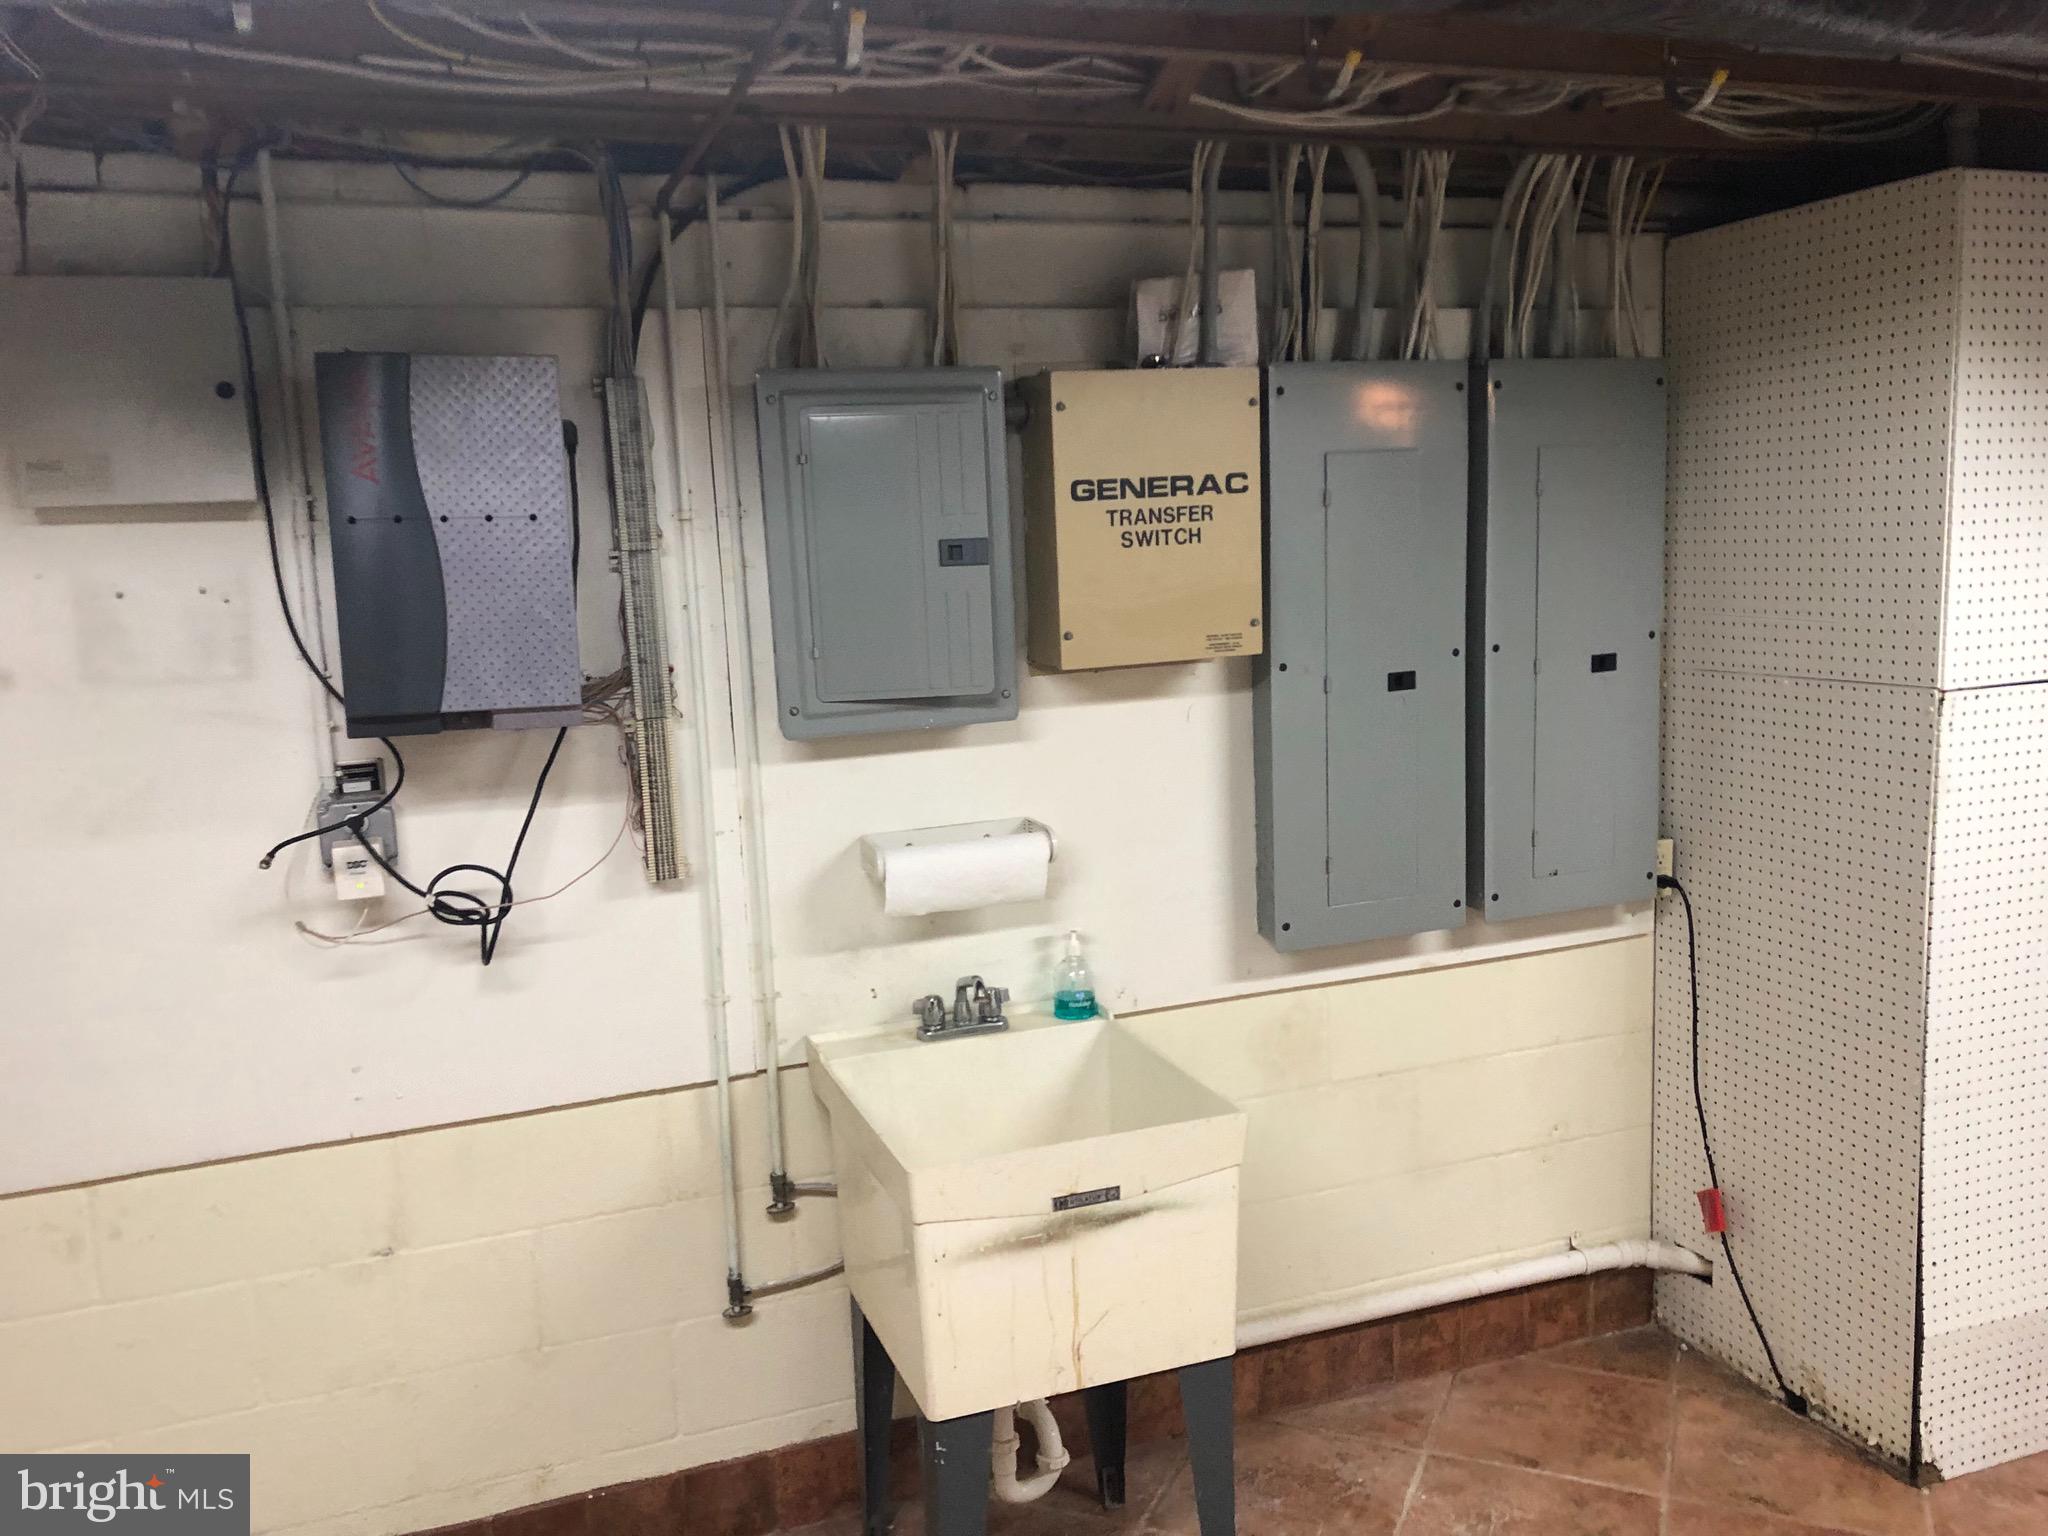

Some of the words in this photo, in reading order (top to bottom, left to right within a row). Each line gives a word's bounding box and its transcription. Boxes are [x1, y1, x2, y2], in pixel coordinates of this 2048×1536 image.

[1070, 471, 1249, 502] GENERAC
[1106, 504, 1214, 527] TRANSFER
[1120, 527, 1202, 548] SWITCH
